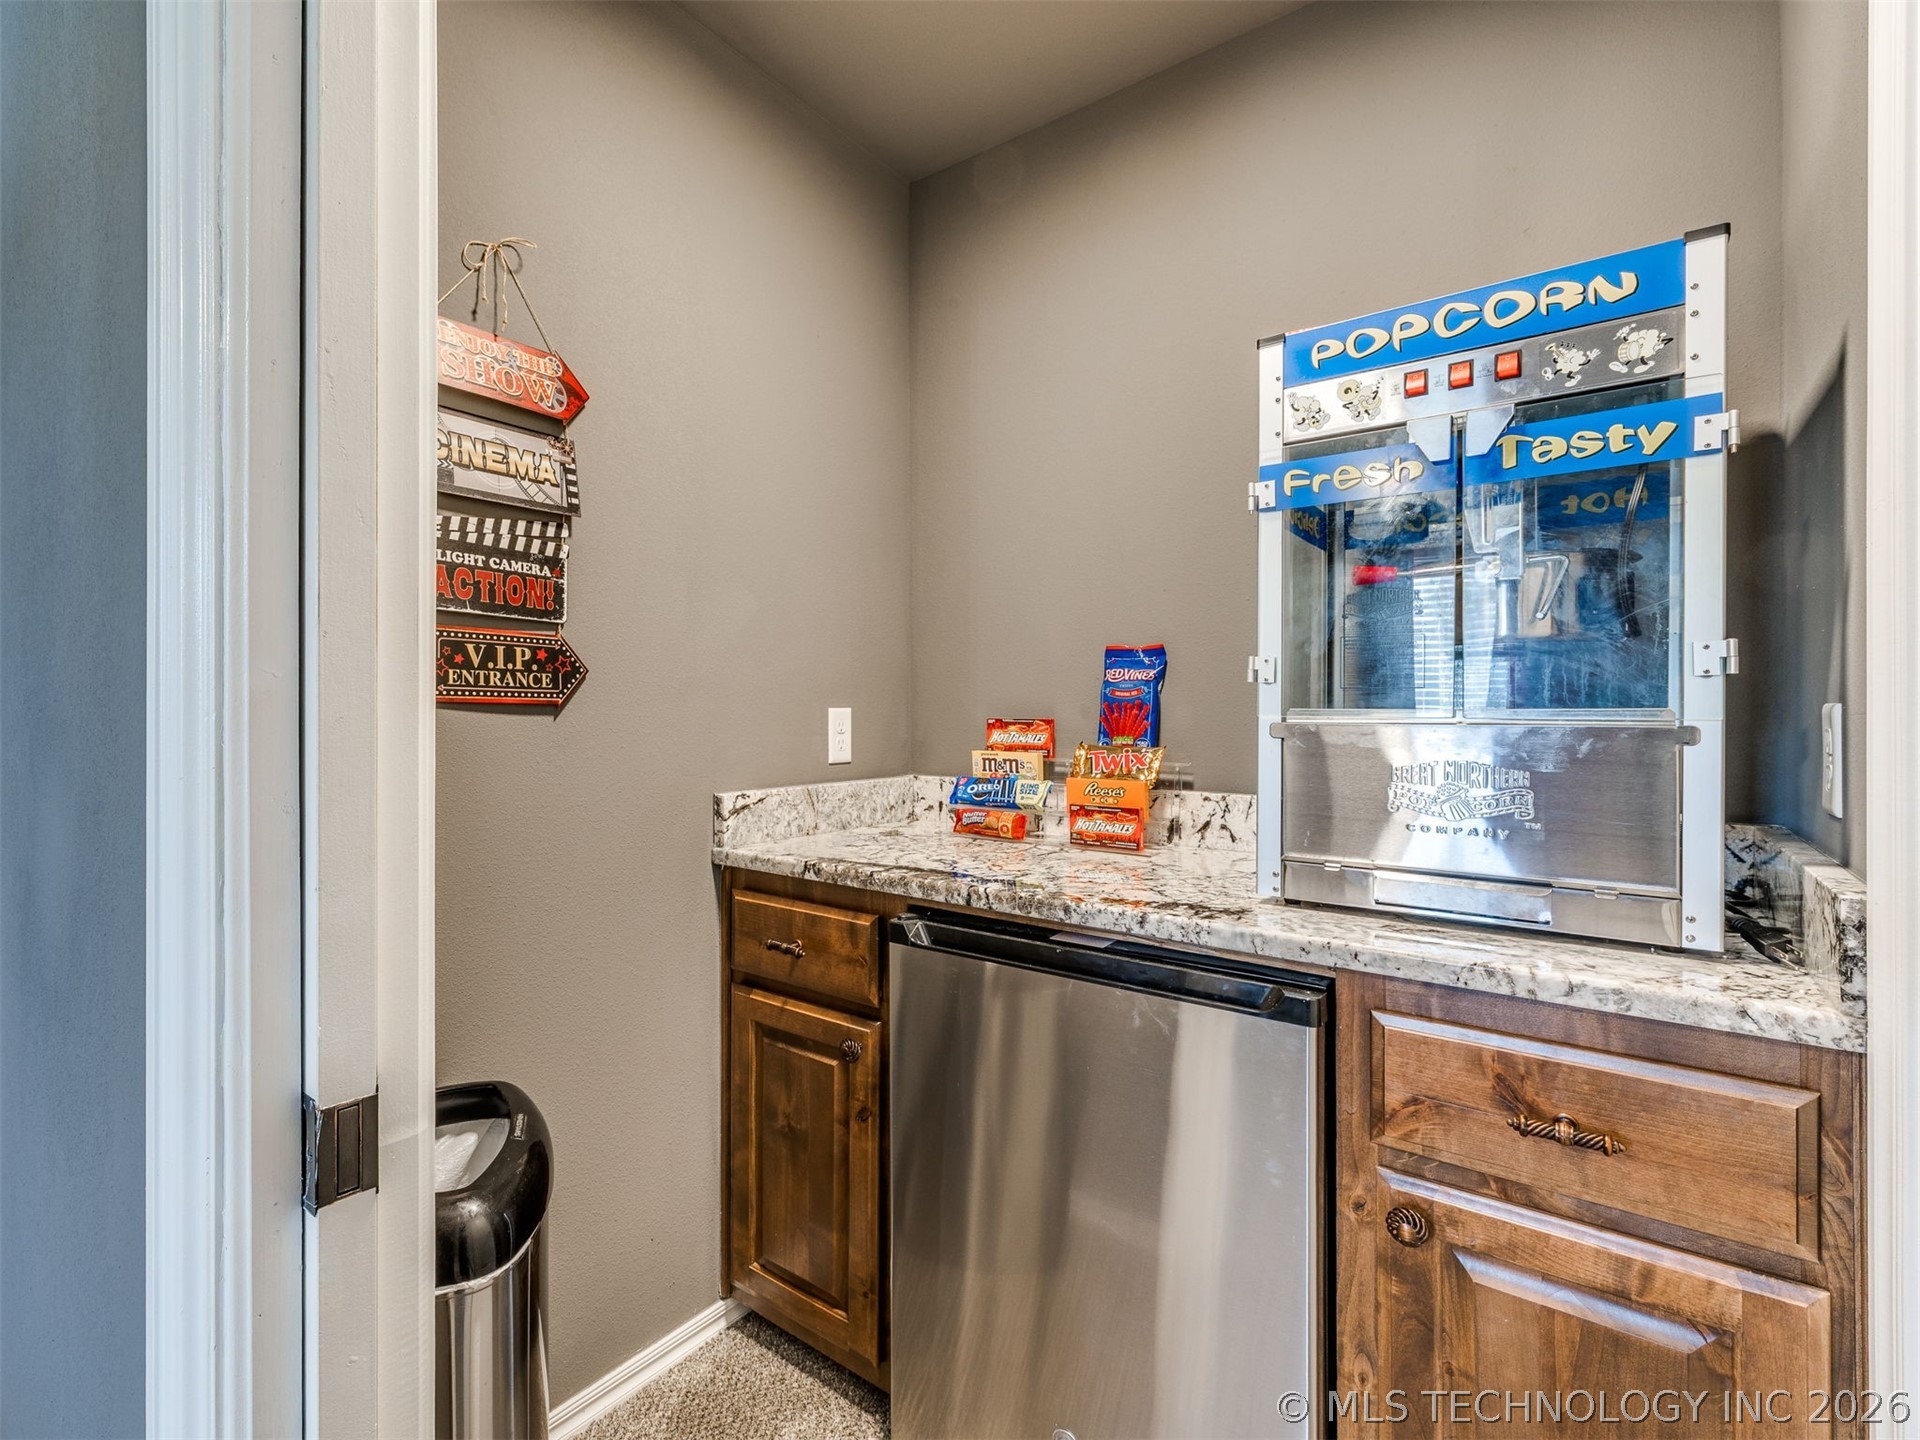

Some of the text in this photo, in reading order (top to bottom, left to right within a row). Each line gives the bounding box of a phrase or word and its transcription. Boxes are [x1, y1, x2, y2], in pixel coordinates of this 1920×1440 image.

[1312, 271, 1639, 370] POPCORN
[438, 327, 557, 377] ENJOY THE
[440, 347, 557, 407] SHOW
[438, 427, 560, 487] CINEMA
[1496, 421, 1678, 470] Tasty
[1283, 456, 1424, 497] Fresh
[437, 549, 552, 577] LIGHT CAMERA
[437, 563, 555, 610] ACTION!
[464, 643, 538, 671] V.I.P.
[447, 669, 553, 688] ENTRANCE
[967, 781, 1001, 794] OREO
[1391, 760, 1531, 789] GREAT NORTHERN
[1473, 795, 1533, 812] CORN
[1405, 823, 1511, 840] COMPANY
